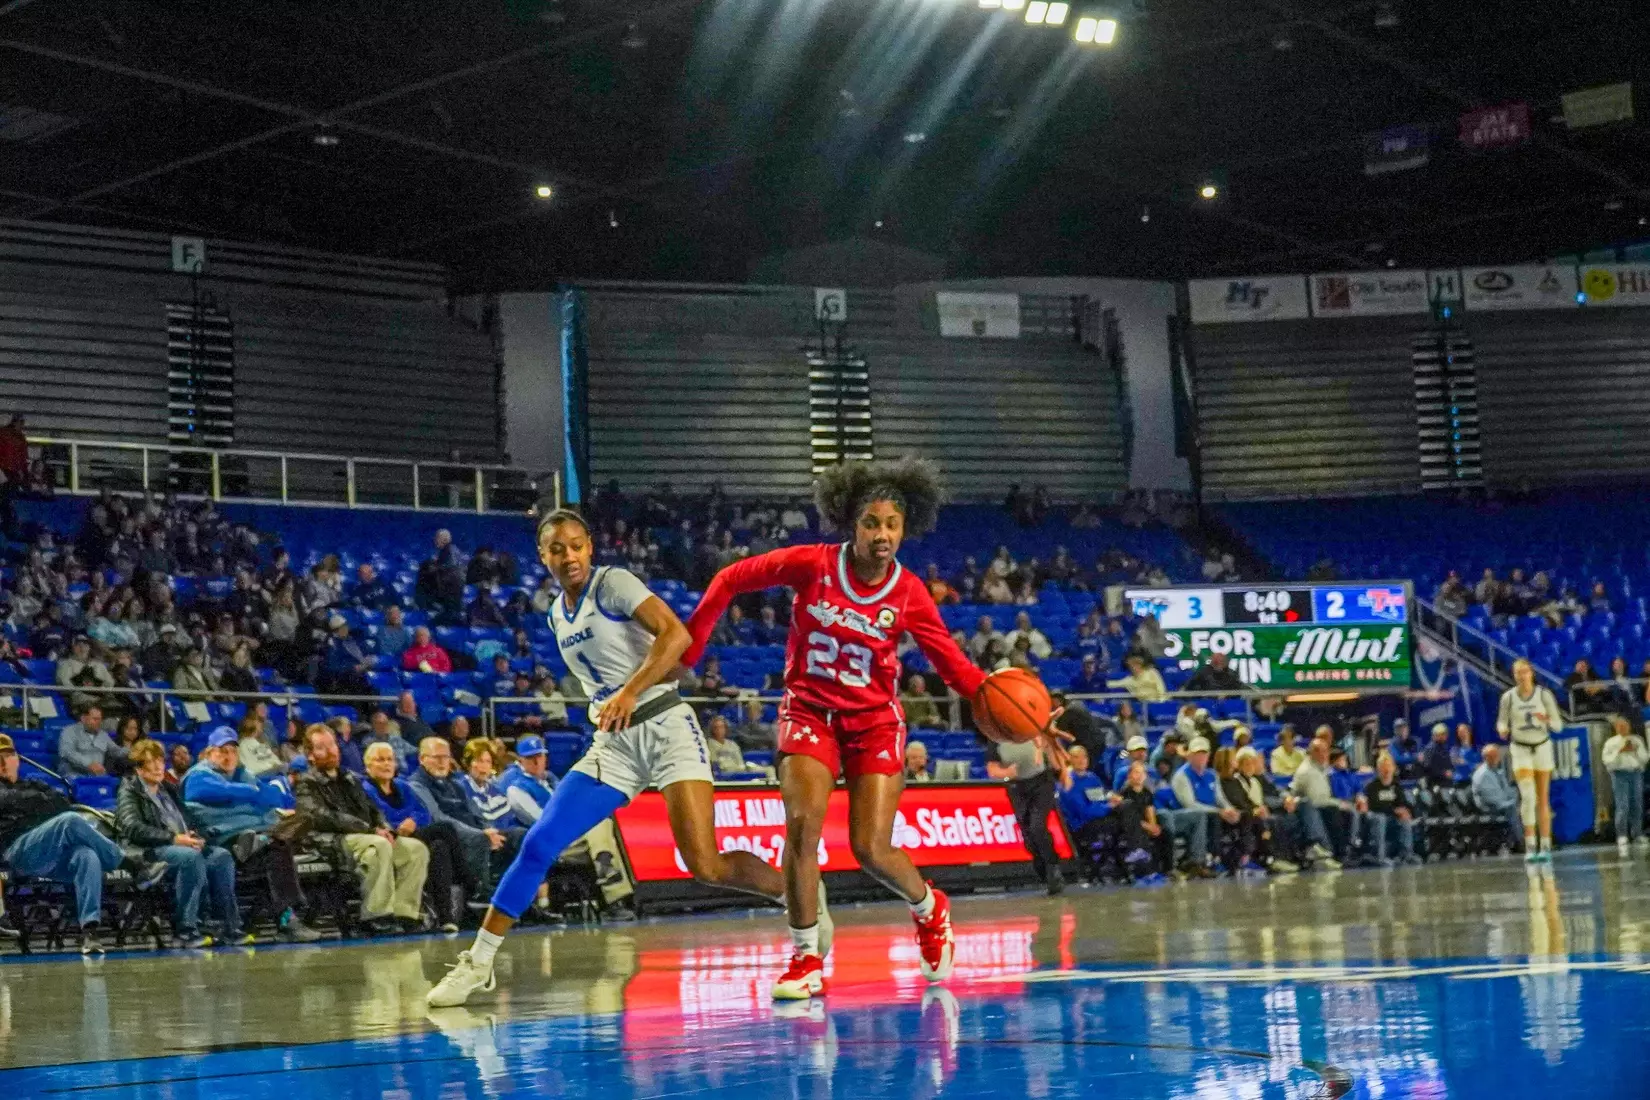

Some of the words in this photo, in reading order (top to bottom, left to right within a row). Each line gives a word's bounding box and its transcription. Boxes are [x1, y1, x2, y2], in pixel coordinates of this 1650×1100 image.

[182, 243, 195, 264] F
[822, 293, 841, 315] G
[1188, 596, 1203, 619] 3
[1244, 590, 1292, 612] 8:49
[1326, 591, 1346, 618] 2
[560, 627, 595, 650] MIDDLE
[1190, 630, 1256, 657] FOR
[1293, 627, 1404, 665] Mint
[576, 651, 604, 684] 1
[806, 630, 874, 688] 23
[916, 806, 1024, 847] StateFar
